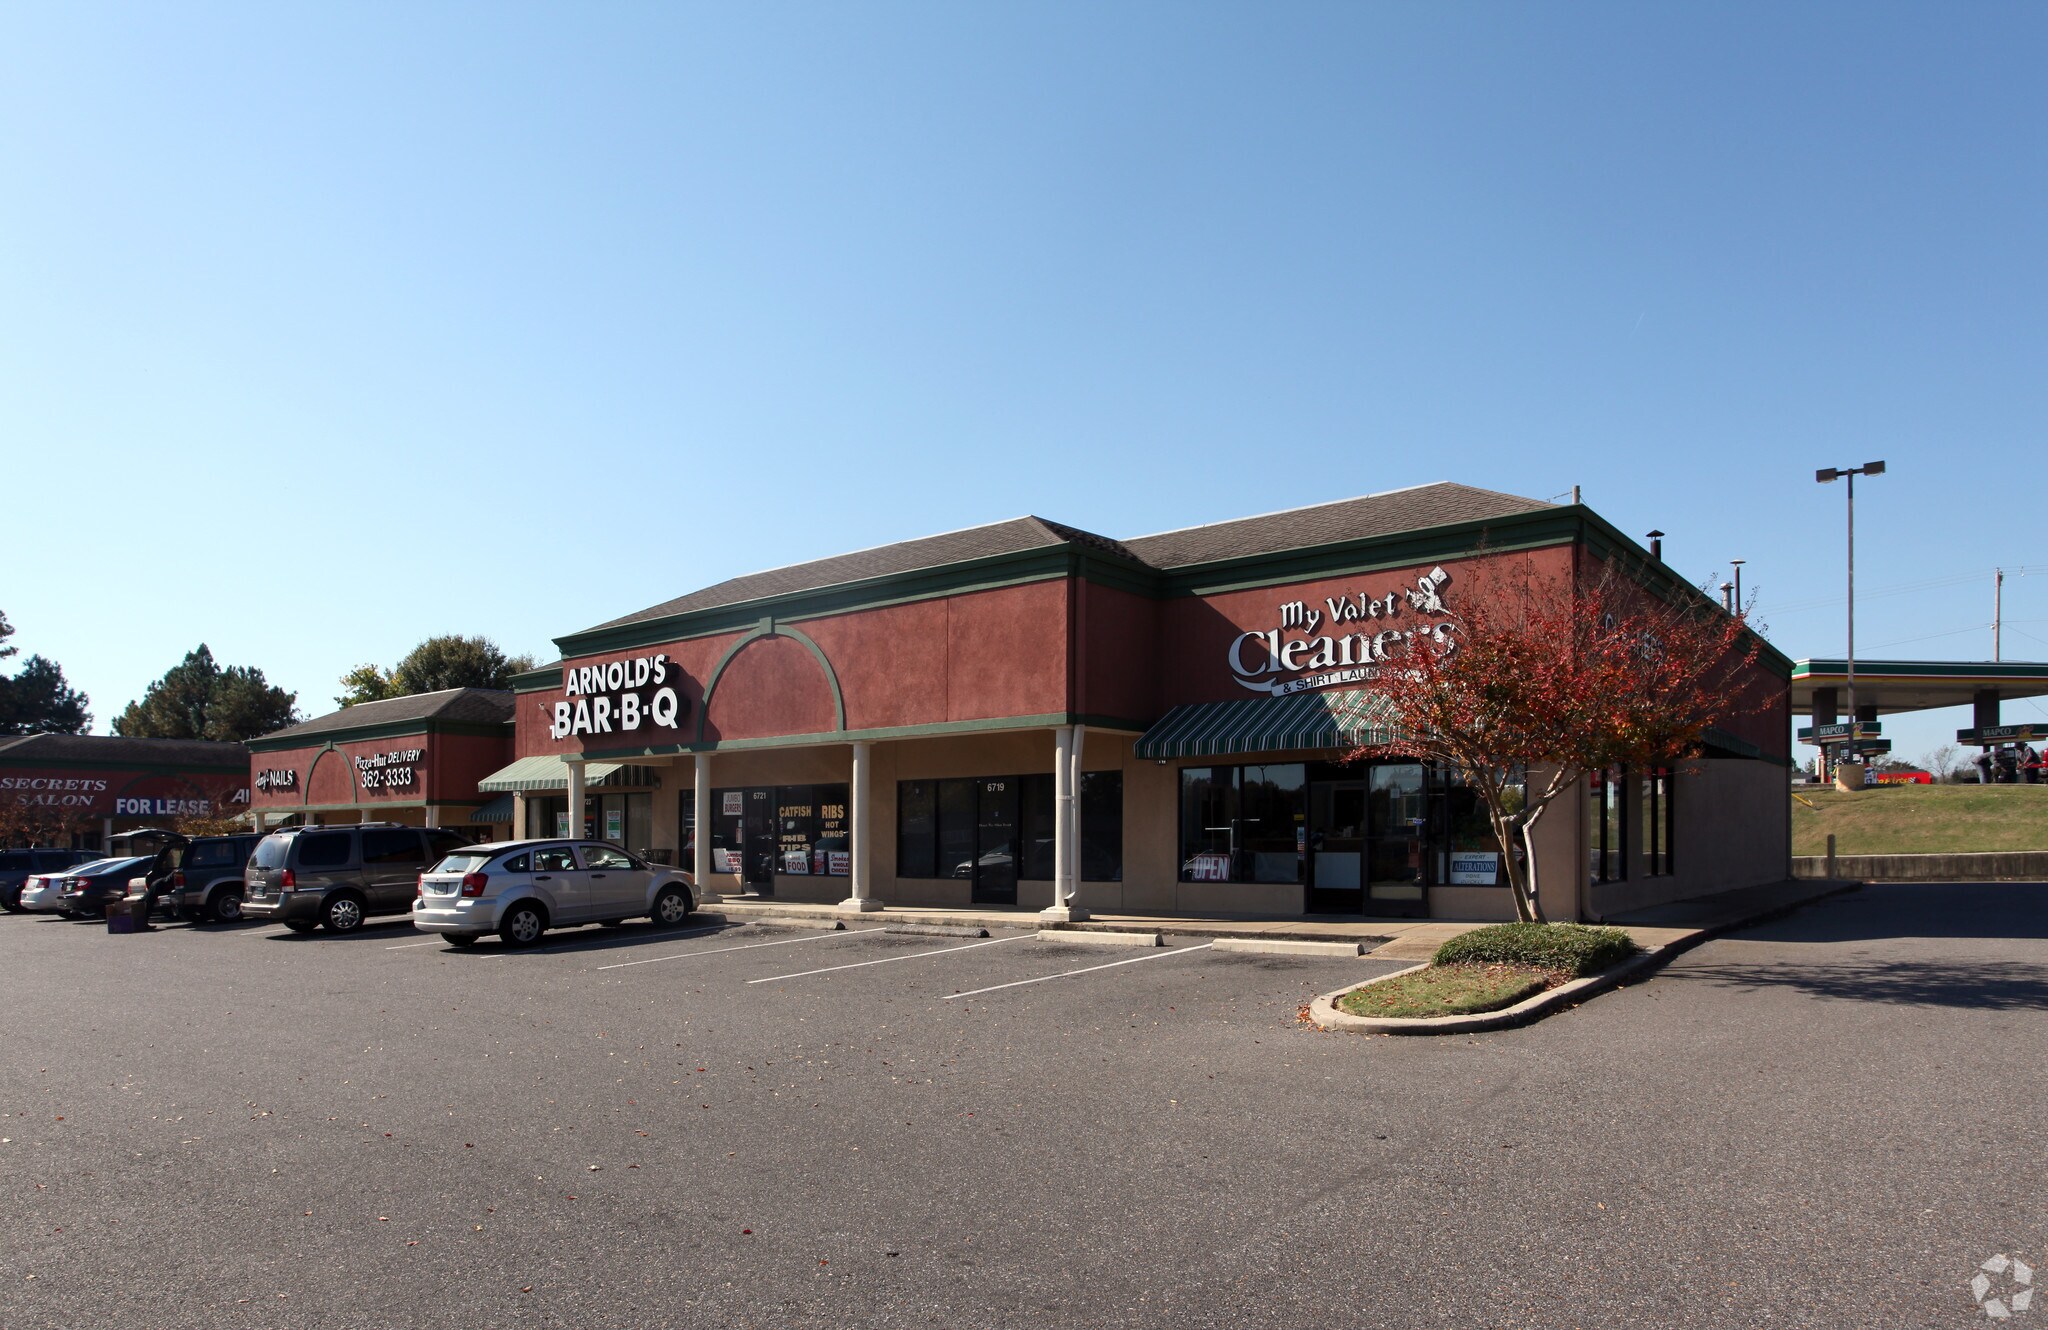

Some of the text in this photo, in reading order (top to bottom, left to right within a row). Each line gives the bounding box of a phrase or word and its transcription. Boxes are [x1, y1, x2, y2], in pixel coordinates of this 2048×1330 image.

[1279, 591, 1397, 634] My Valet
[566, 654, 666, 697] ARNOLD'S
[1283, 684, 1292, 695] &
[1296, 675, 1333, 692] SHIRT
[1819, 725, 1845, 736] MAPCO
[1983, 727, 2011, 737] MAPCO
[388, 749, 421, 764] DELIVERY
[0, 777, 107, 791] SECRETS
[270, 770, 293, 786] NAILS
[361, 767, 412, 789] 362-3333
[987, 783, 1004, 791] 6719
[16, 794, 94, 806] SALON
[753, 792, 766, 800] 6721
[117, 798, 208, 815] FOR LEASE
[725, 804, 741, 813] BURGERS
[779, 806, 812, 818] CATFISH
[821, 804, 845, 819] RIBS
[825, 821, 839, 829] HOT
[782, 834, 806, 843] RIB
[821, 830, 844, 838] WINGS
[778, 843, 812, 852] TIPS
[787, 861, 807, 872] FOOD
[1195, 857, 1229, 880] OPEN
[1453, 862, 1495, 872] ALTERATIONS
